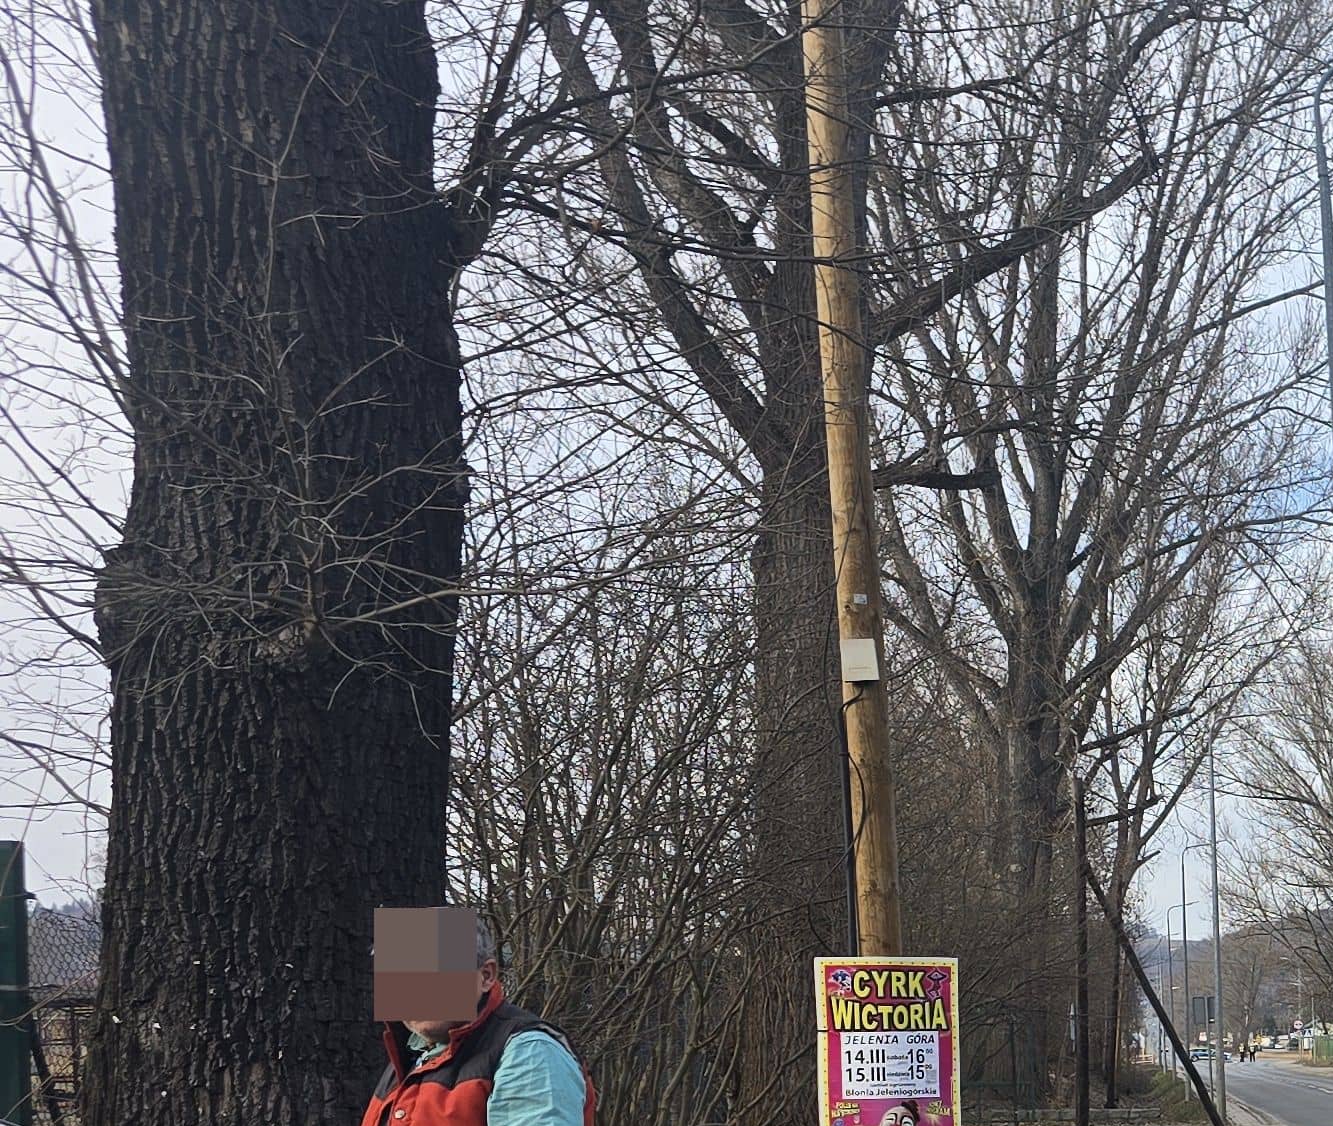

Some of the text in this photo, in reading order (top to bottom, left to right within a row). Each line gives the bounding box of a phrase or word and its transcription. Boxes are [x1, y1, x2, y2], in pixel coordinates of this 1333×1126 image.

[852, 970, 926, 1000] CYRK
[830, 996, 948, 1032] WICTORIA
[844, 1033, 935, 1045] JELENIA GÓRA
[845, 1049, 886, 1065] 14.III
[846, 1066, 887, 1082] 15.III
